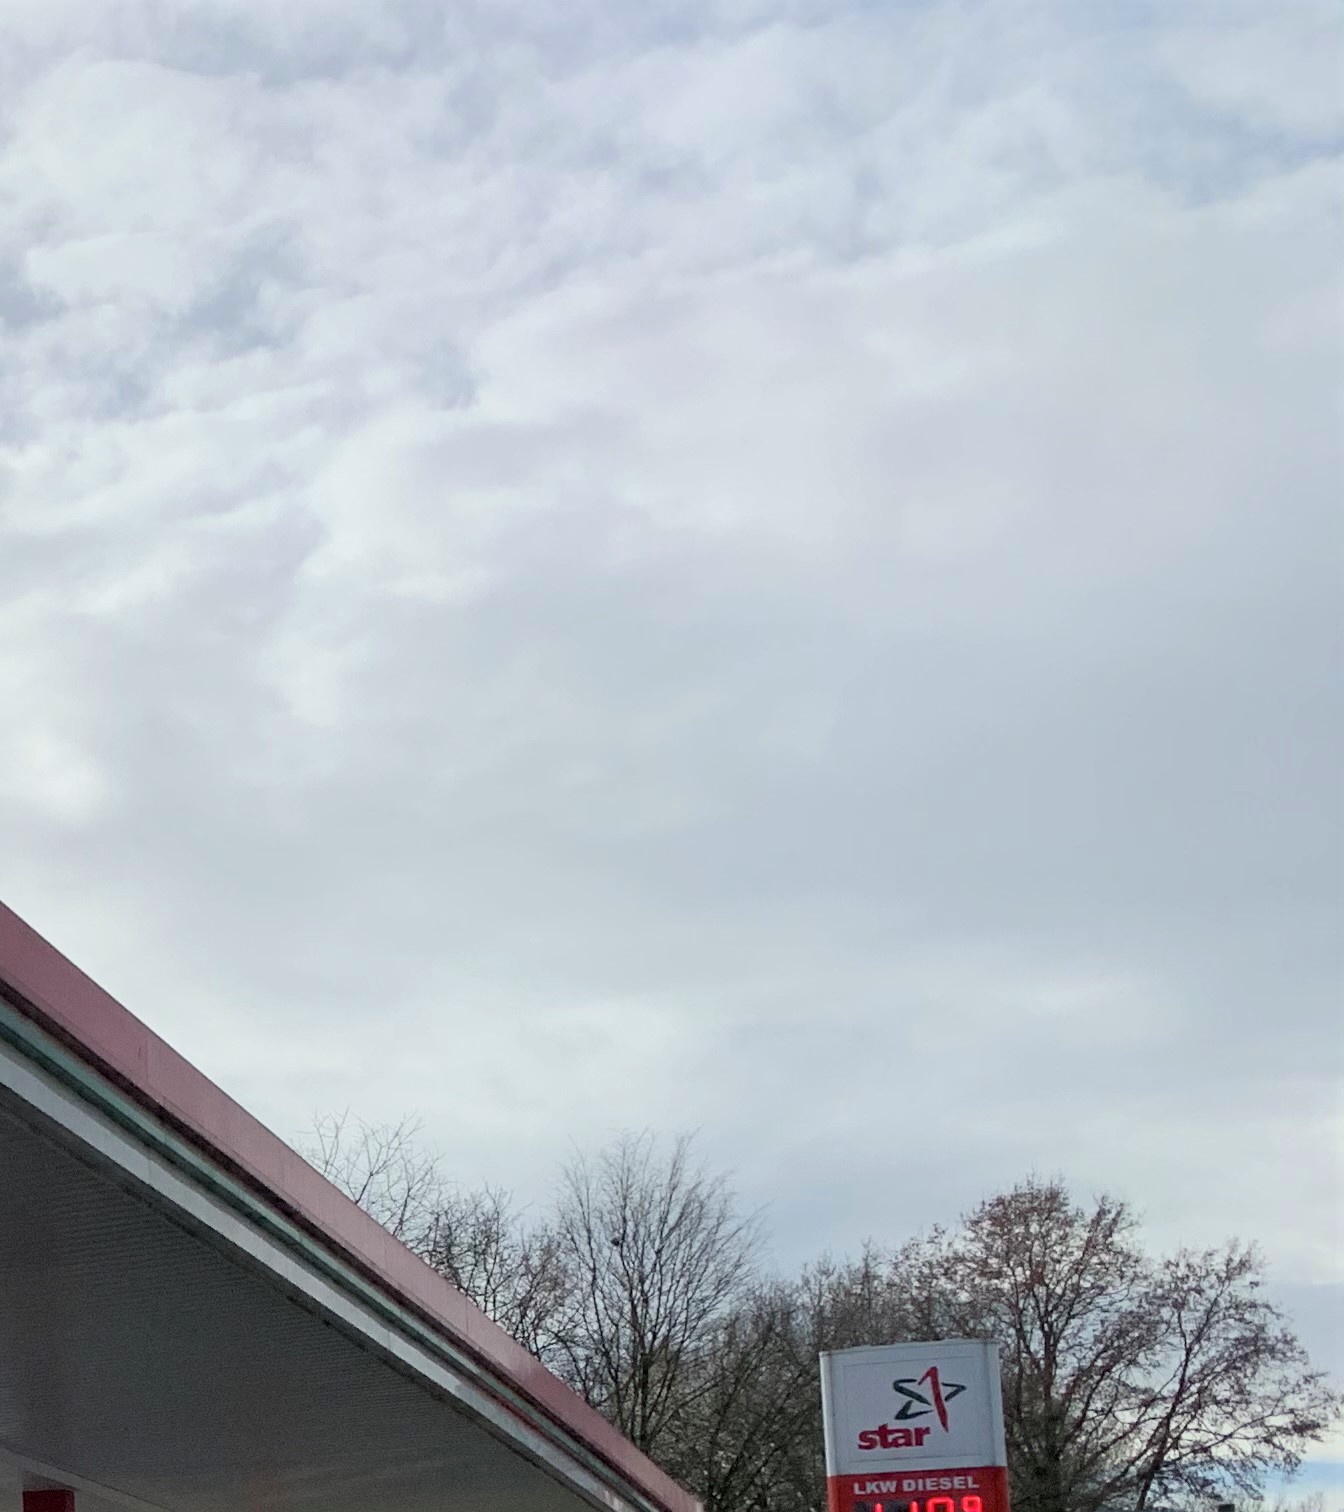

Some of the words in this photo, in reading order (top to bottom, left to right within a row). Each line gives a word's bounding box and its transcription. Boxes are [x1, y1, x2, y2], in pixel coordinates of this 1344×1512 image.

[858, 1423, 931, 1450] star
[854, 1480, 896, 1495] LKW
[903, 1476, 979, 1491] DIESEL
